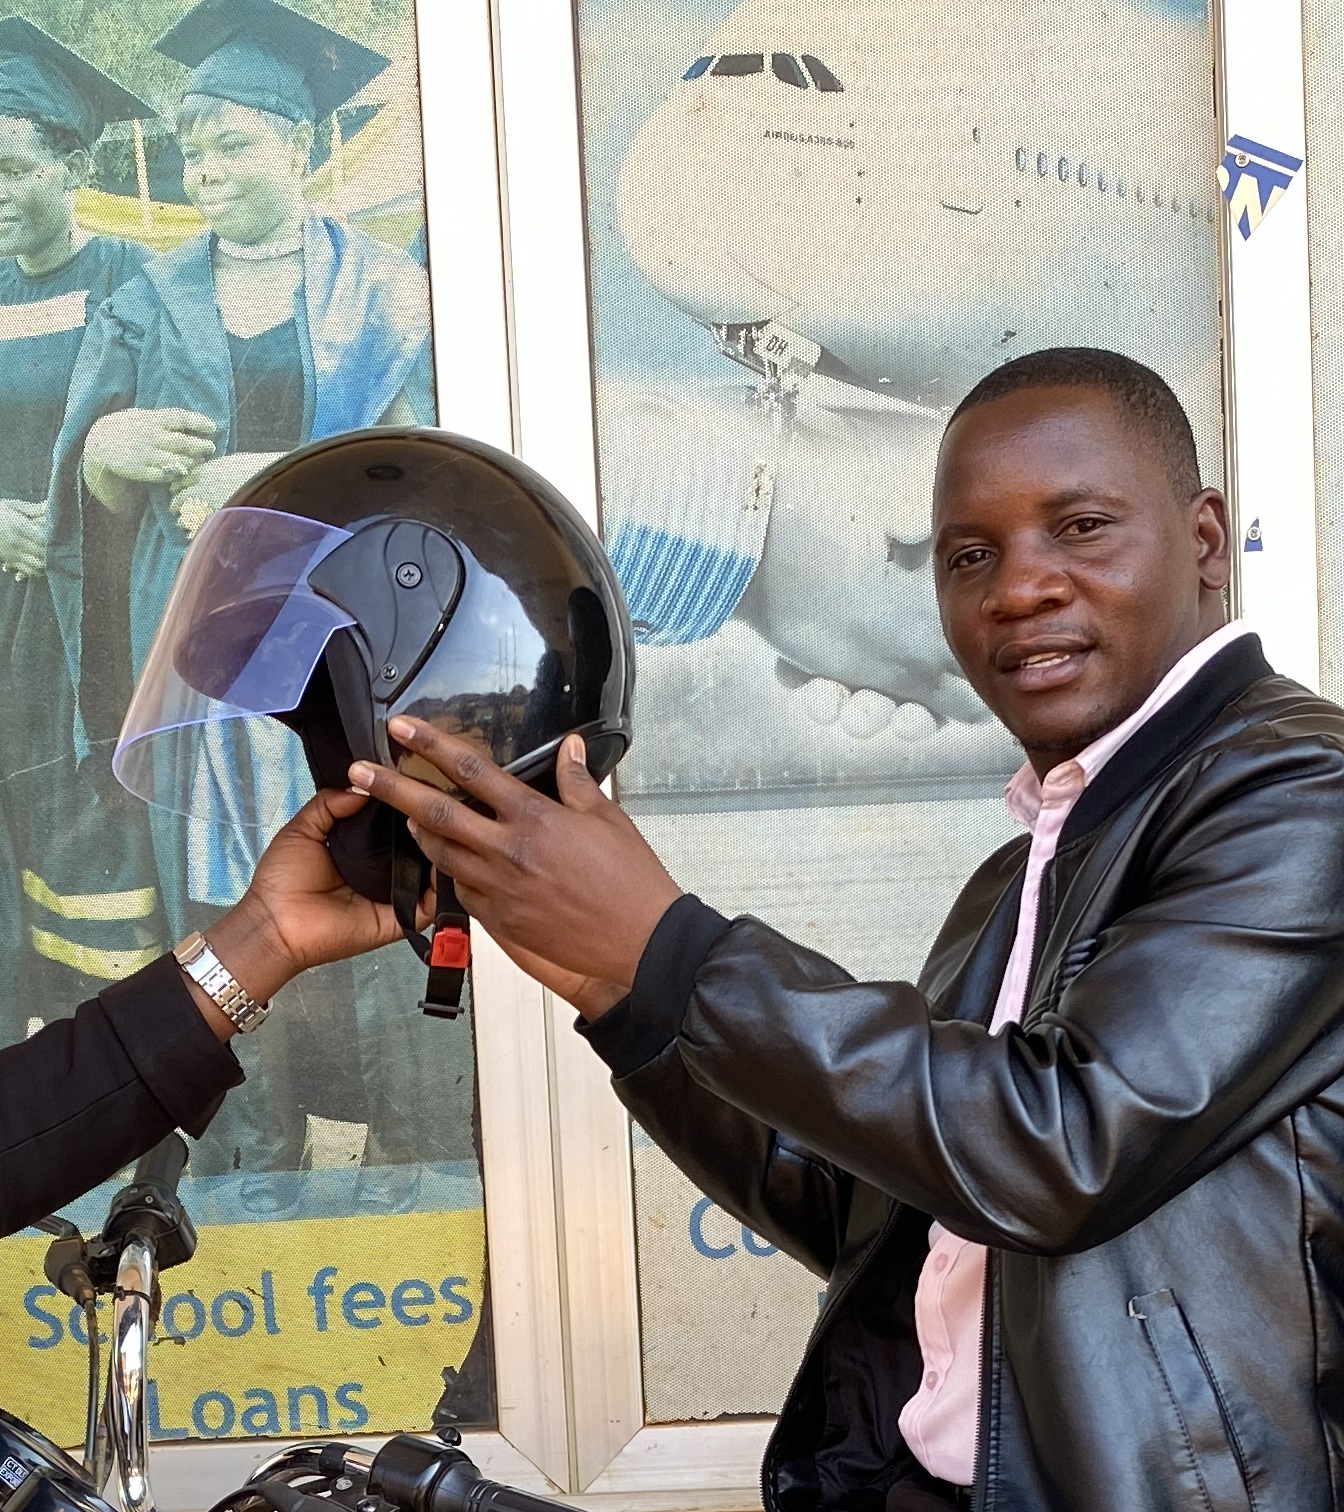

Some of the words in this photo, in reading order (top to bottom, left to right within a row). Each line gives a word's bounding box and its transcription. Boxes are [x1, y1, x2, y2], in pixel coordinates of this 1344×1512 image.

[23, 1270, 281, 1350] Scool
[307, 1266, 473, 1332] fees
[147, 1379, 370, 1440] Loans
